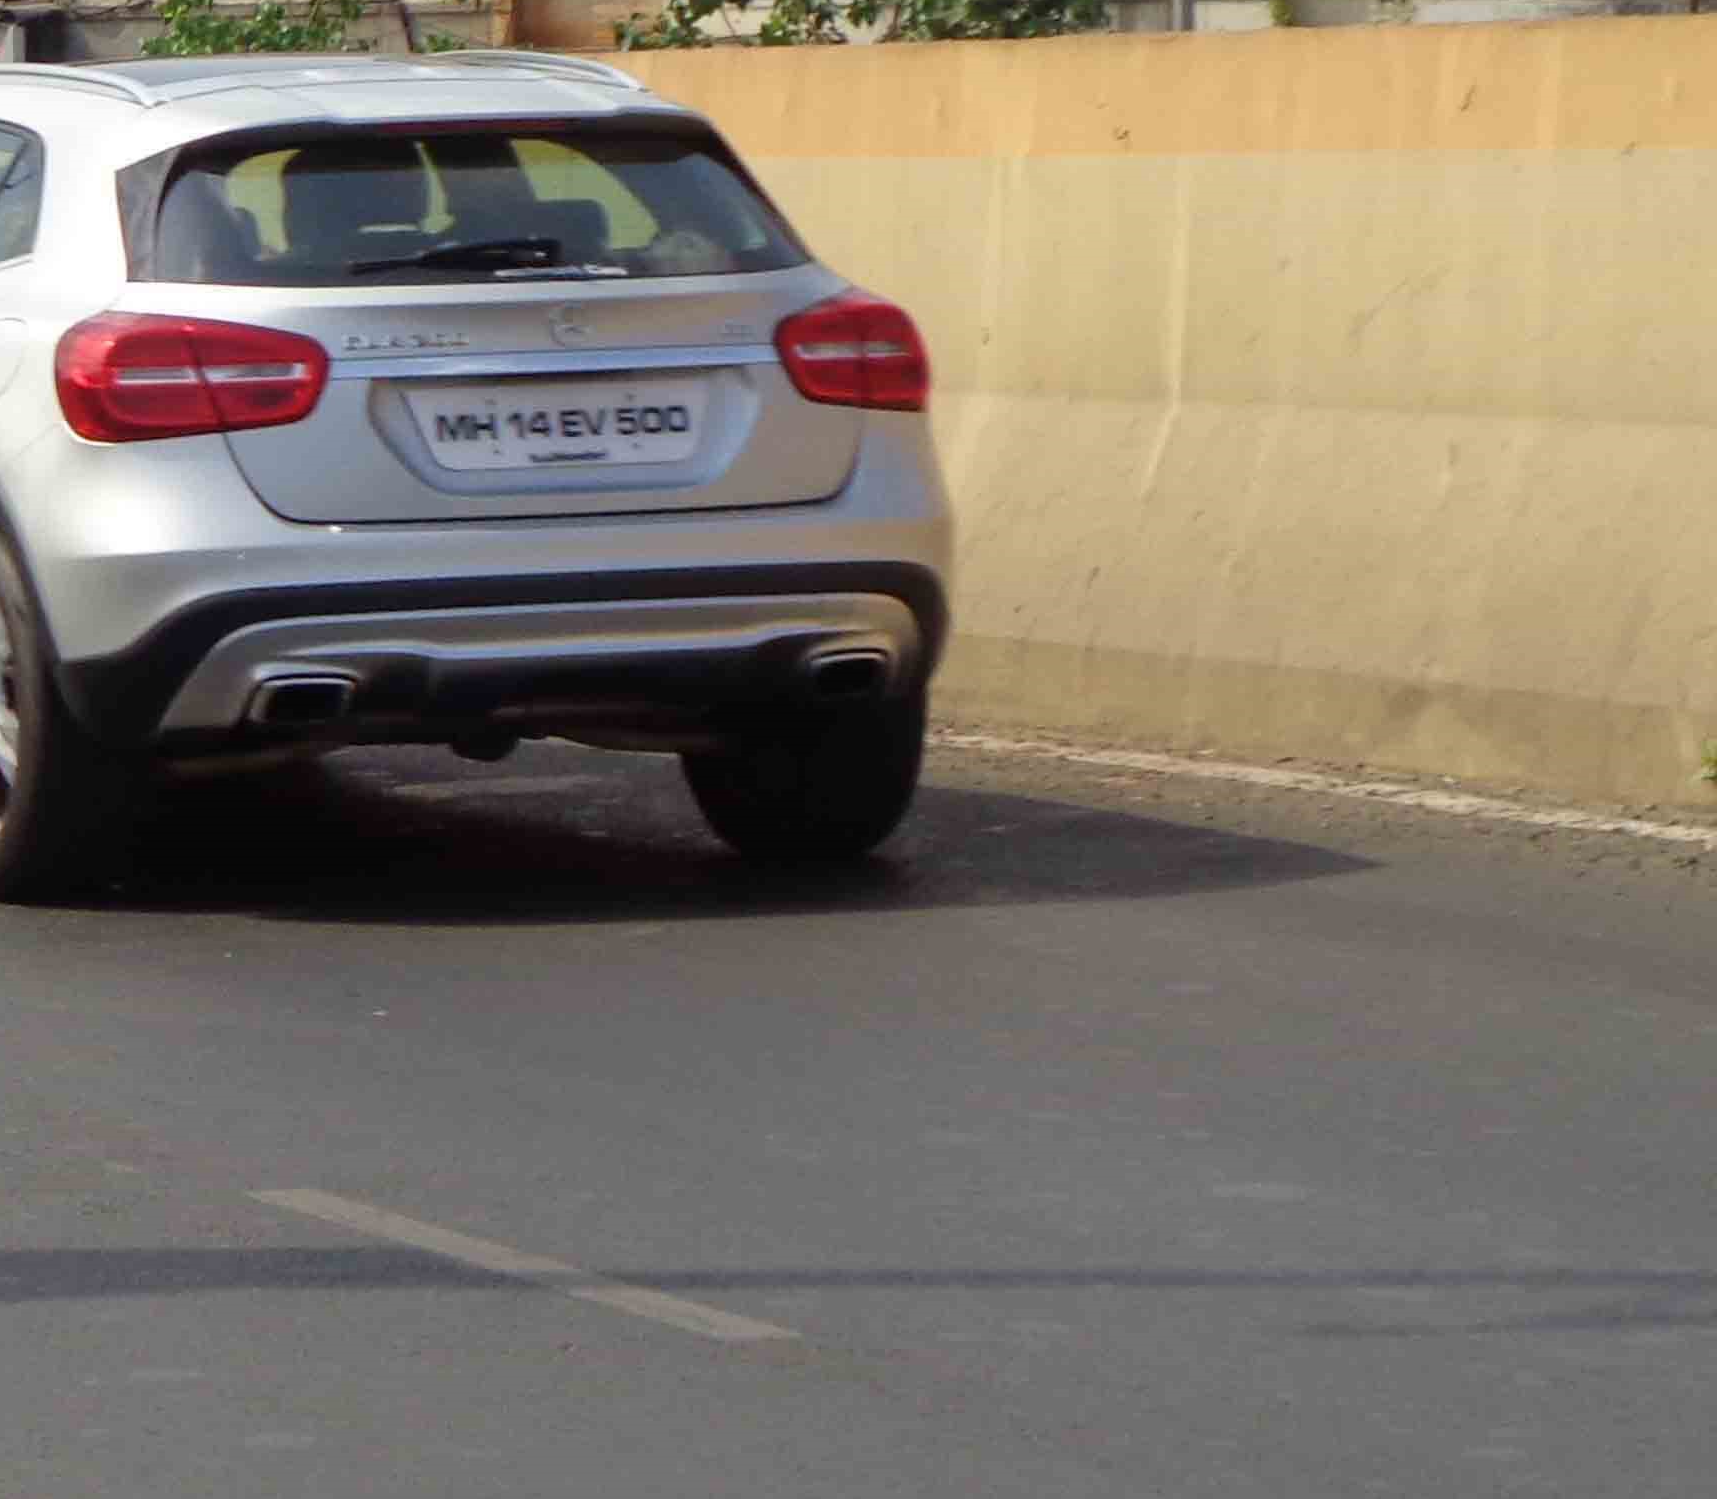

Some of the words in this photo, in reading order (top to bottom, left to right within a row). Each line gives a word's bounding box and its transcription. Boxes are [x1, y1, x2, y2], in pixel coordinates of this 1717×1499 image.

[435, 412, 499, 442] MH
[507, 410, 551, 439] 14
[559, 408, 607, 437] EV
[616, 405, 690, 435] 500
